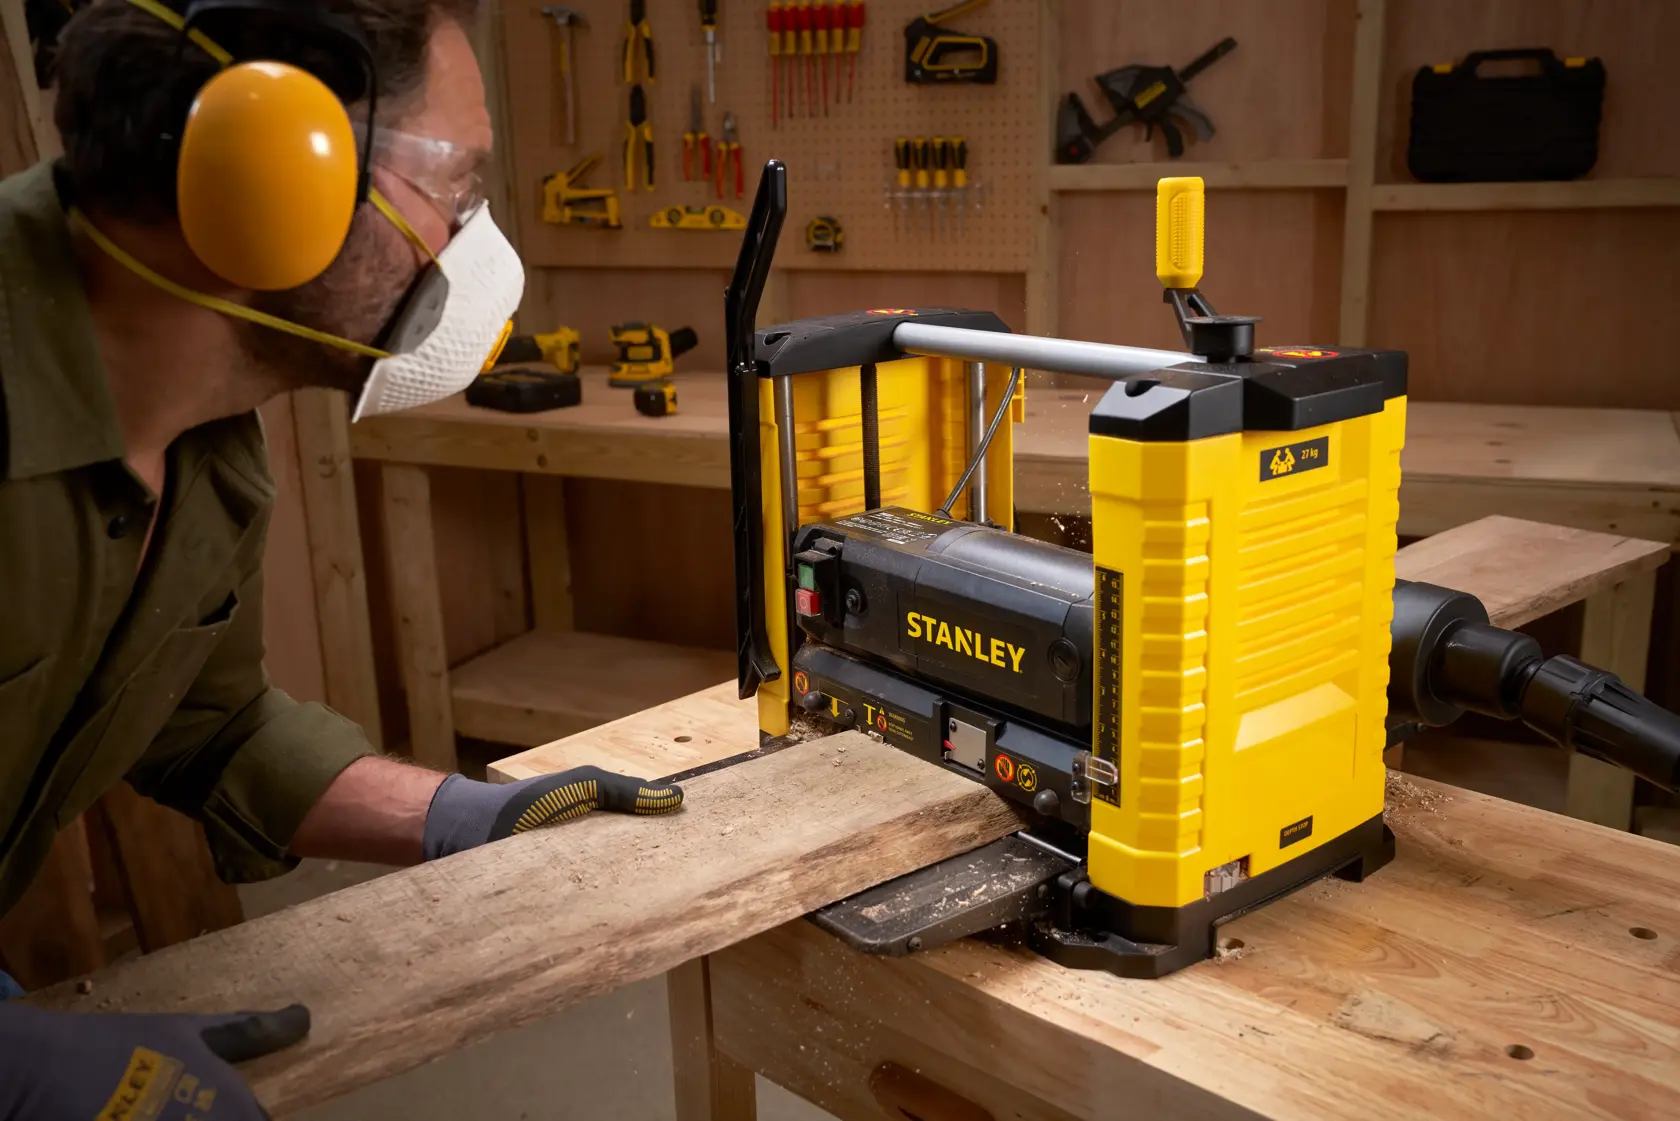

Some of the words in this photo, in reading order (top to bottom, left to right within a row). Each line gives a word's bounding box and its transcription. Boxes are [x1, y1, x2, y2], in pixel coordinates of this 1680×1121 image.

[1301, 449, 1310, 460] 27
[1310, 447, 1319, 459] kg
[907, 611, 1026, 673] STANLEY
